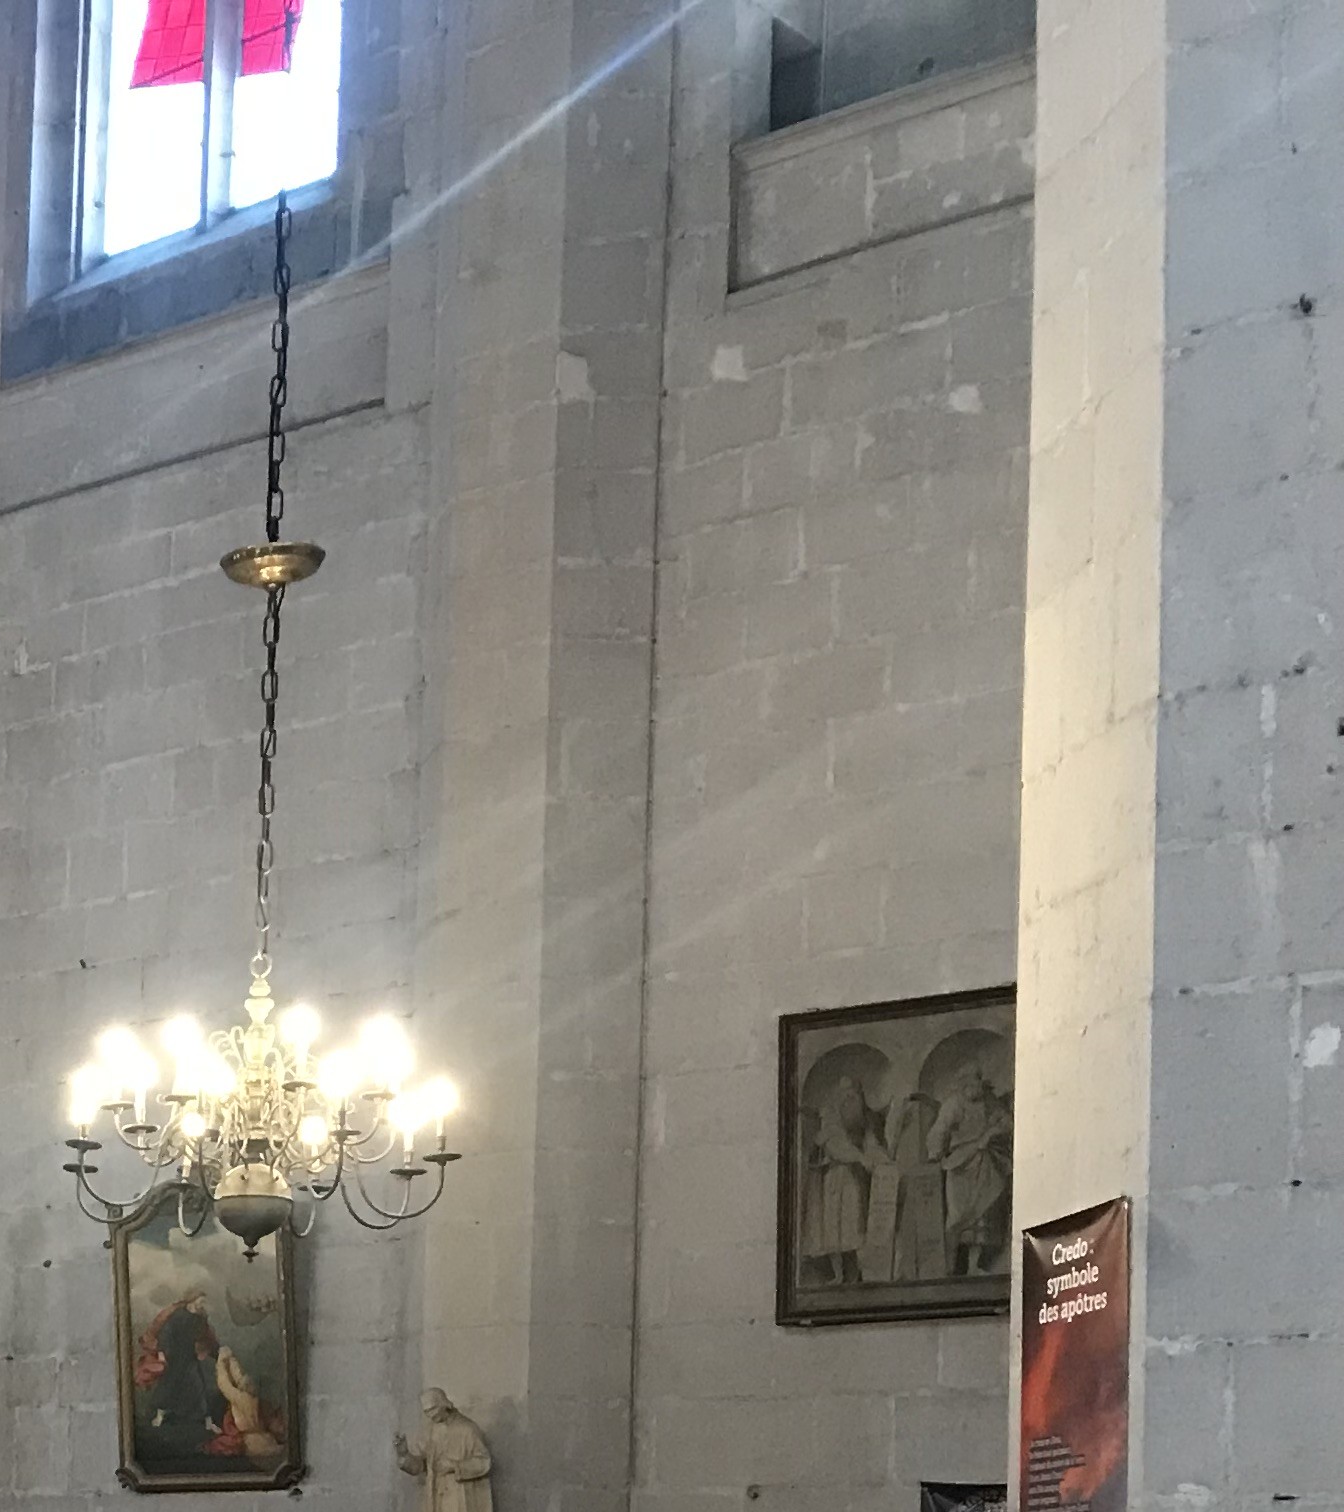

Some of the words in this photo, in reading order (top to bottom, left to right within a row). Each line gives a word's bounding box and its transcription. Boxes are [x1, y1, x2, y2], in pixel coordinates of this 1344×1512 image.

[1047, 1262, 1099, 1298] symbole
[1039, 1302, 1059, 1325] des
[1060, 1291, 1108, 1323] apôtres
